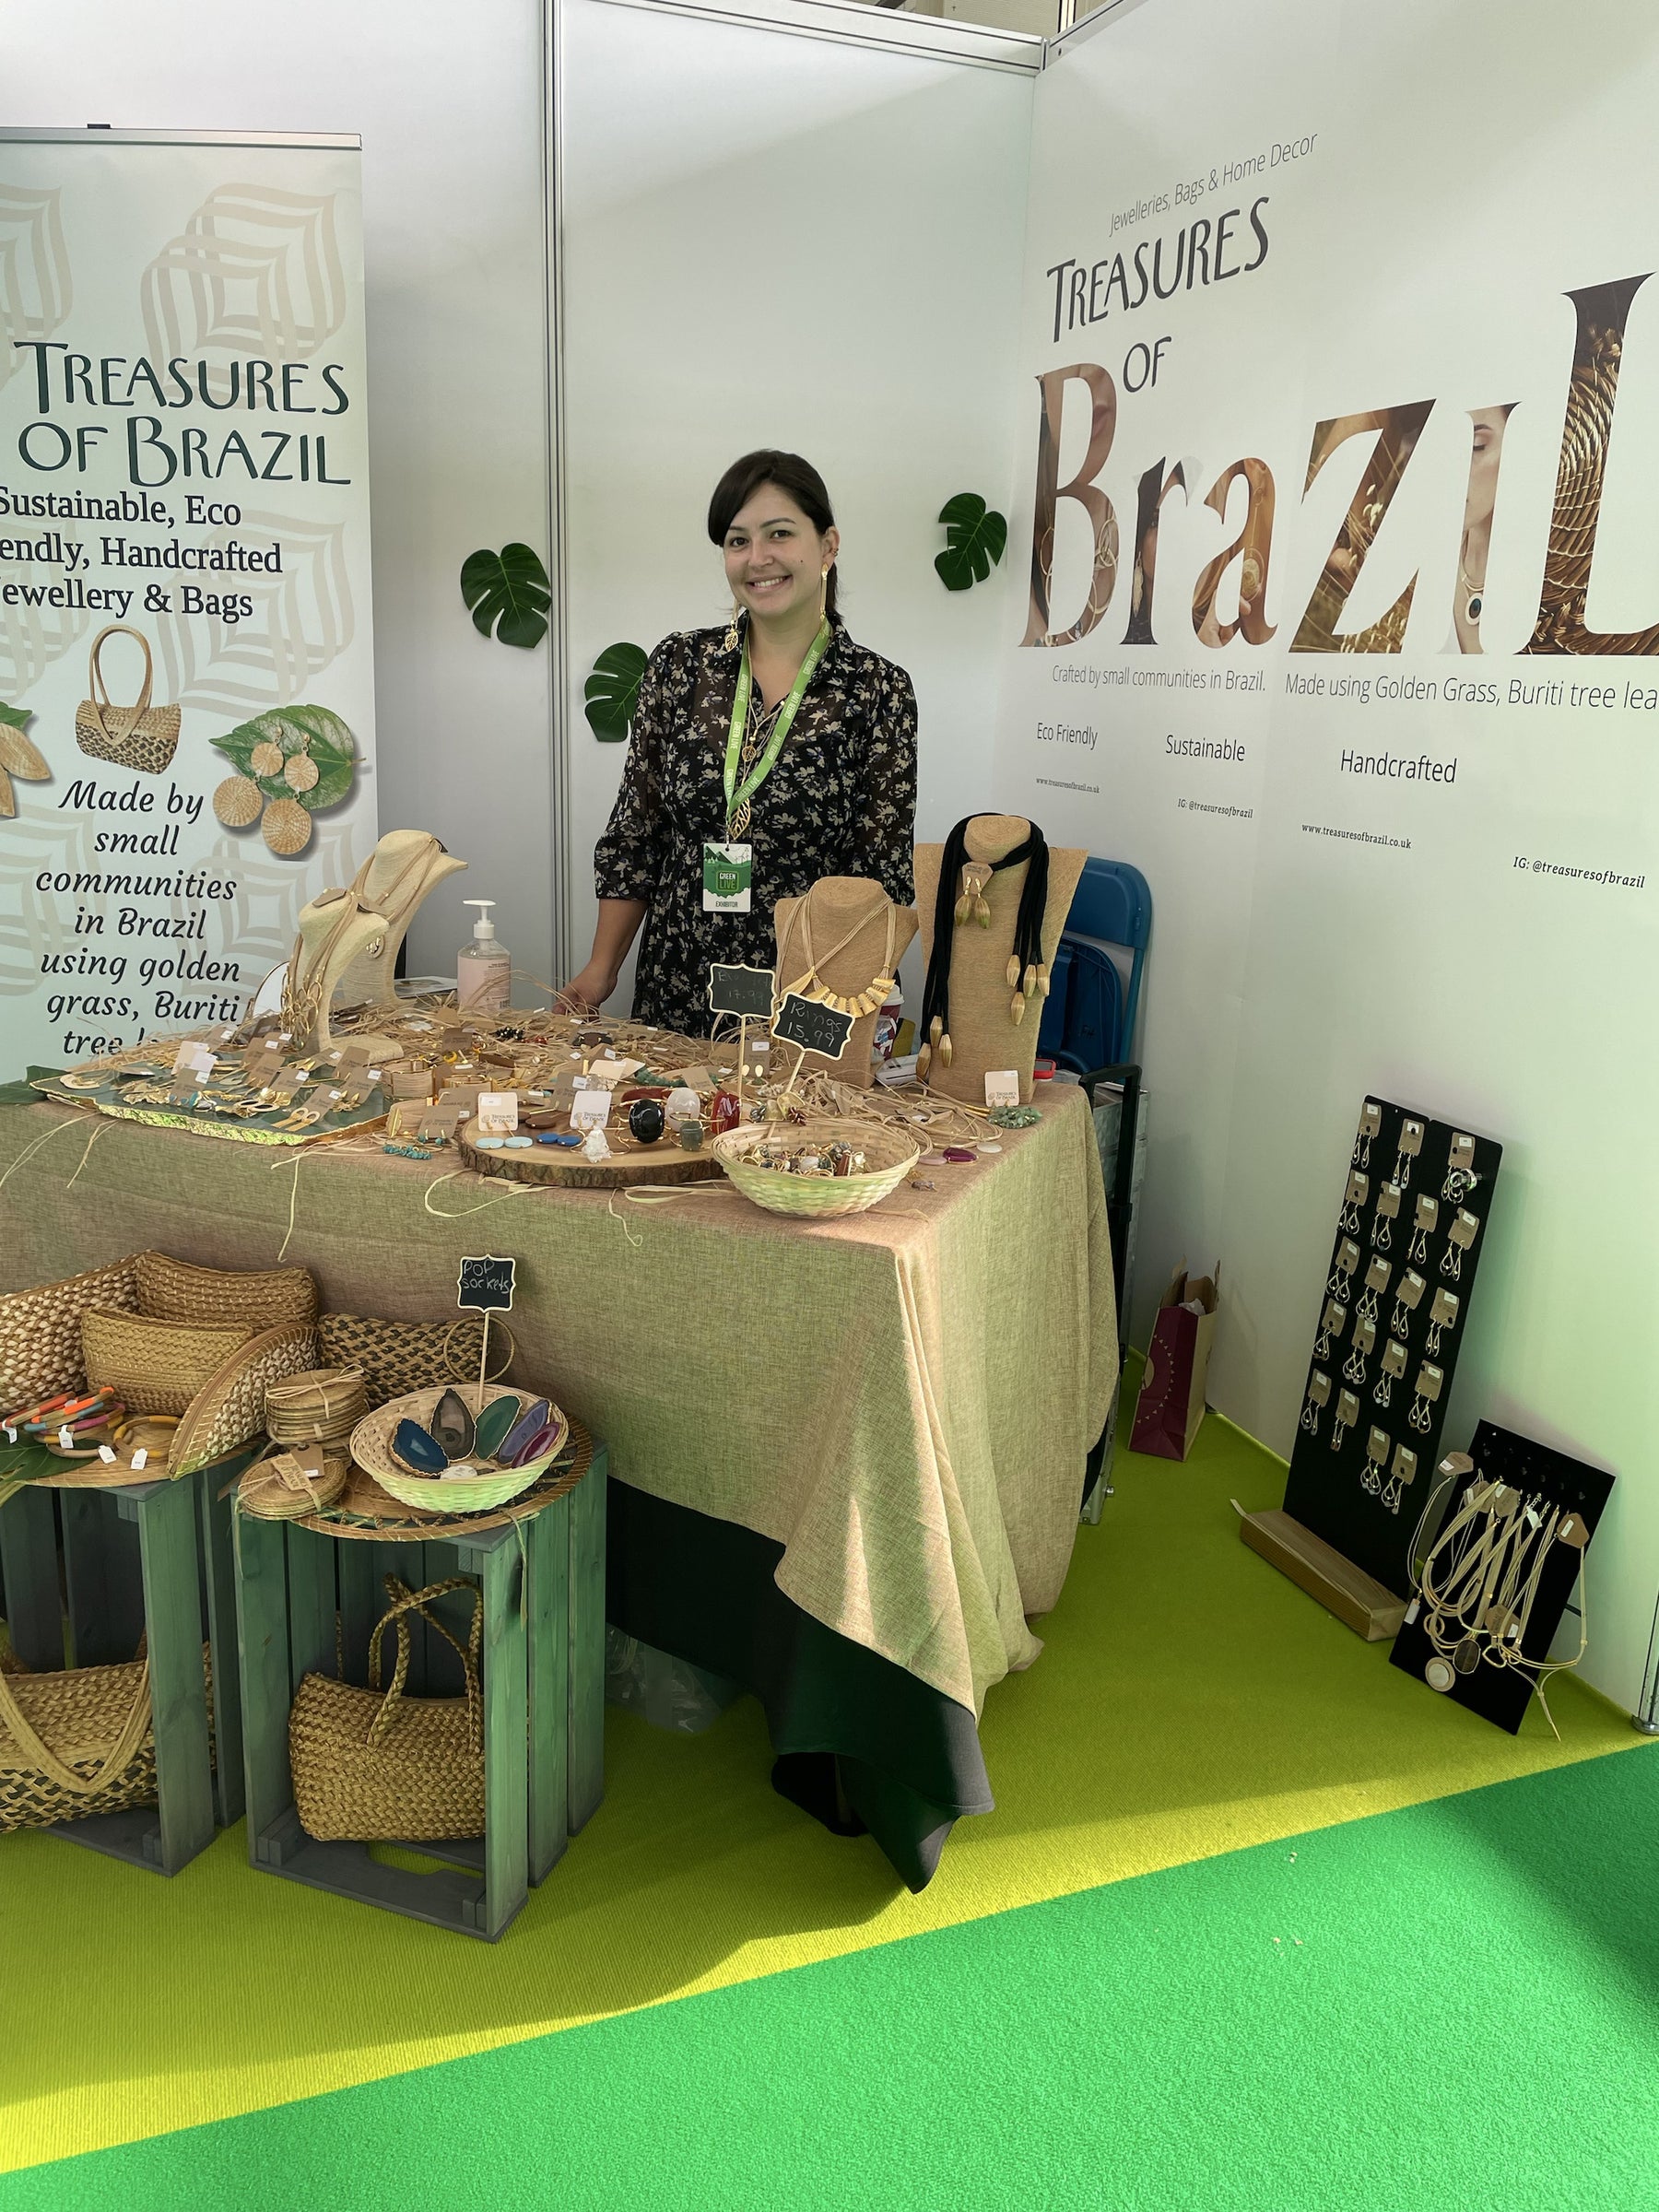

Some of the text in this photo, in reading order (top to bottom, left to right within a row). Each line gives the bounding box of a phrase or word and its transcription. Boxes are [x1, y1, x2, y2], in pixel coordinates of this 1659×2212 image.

[1109, 134, 1318, 238] Jewelleries, Bags & Home Decor
[1046, 196, 1270, 344] TREASURES
[13, 341, 349, 415] TREASURES
[1123, 336, 1172, 393] OF
[18, 416, 351, 488] OF BRAZIL
[0, 486, 241, 528] Sustainable, Eco
[100, 536, 284, 573] Handcrafted
[0, 577, 253, 624] ewellery & Bags
[1052, 665, 1086, 684] Crafted
[1088, 666, 1101, 688] by
[1102, 665, 1130, 685] small
[1132, 668, 1206, 689] communities
[1209, 669, 1222, 689] in
[1225, 670, 1266, 691] Brazil.
[1285, 673, 1325, 696] Made
[1329, 675, 1371, 703] using
[1375, 675, 1438, 701] Golden
[1443, 677, 1500, 707] Grass,
[1508, 679, 1564, 707] Buriti
[1570, 683, 1616, 709] tree
[1036, 723, 1098, 750] Eco Friendly
[1165, 734, 1245, 762] Sustainable
[1340, 749, 1457, 782] Handcrafted
[58, 780, 204, 824] Made by
[1177, 798, 1253, 819] IG: @treasuresofbrazil
[94, 825, 180, 855] small
[1301, 822, 1412, 850] www.treasuresofbrazil.co.uk
[35, 869, 237, 900] communities
[719, 879, 735, 889] LIVE
[1512, 856, 1646, 889] IG: @treasuresofbrazil
[74, 906, 206, 939] in Brazil
[41, 947, 240, 986] using golden
[47, 990, 241, 1023] grass, Buriti
[790, 1001, 842, 1034] Rings
[64, 1030, 123, 1054] tree
[786, 1020, 835, 1048] 15.99
[464, 1259, 495, 1277] POP
